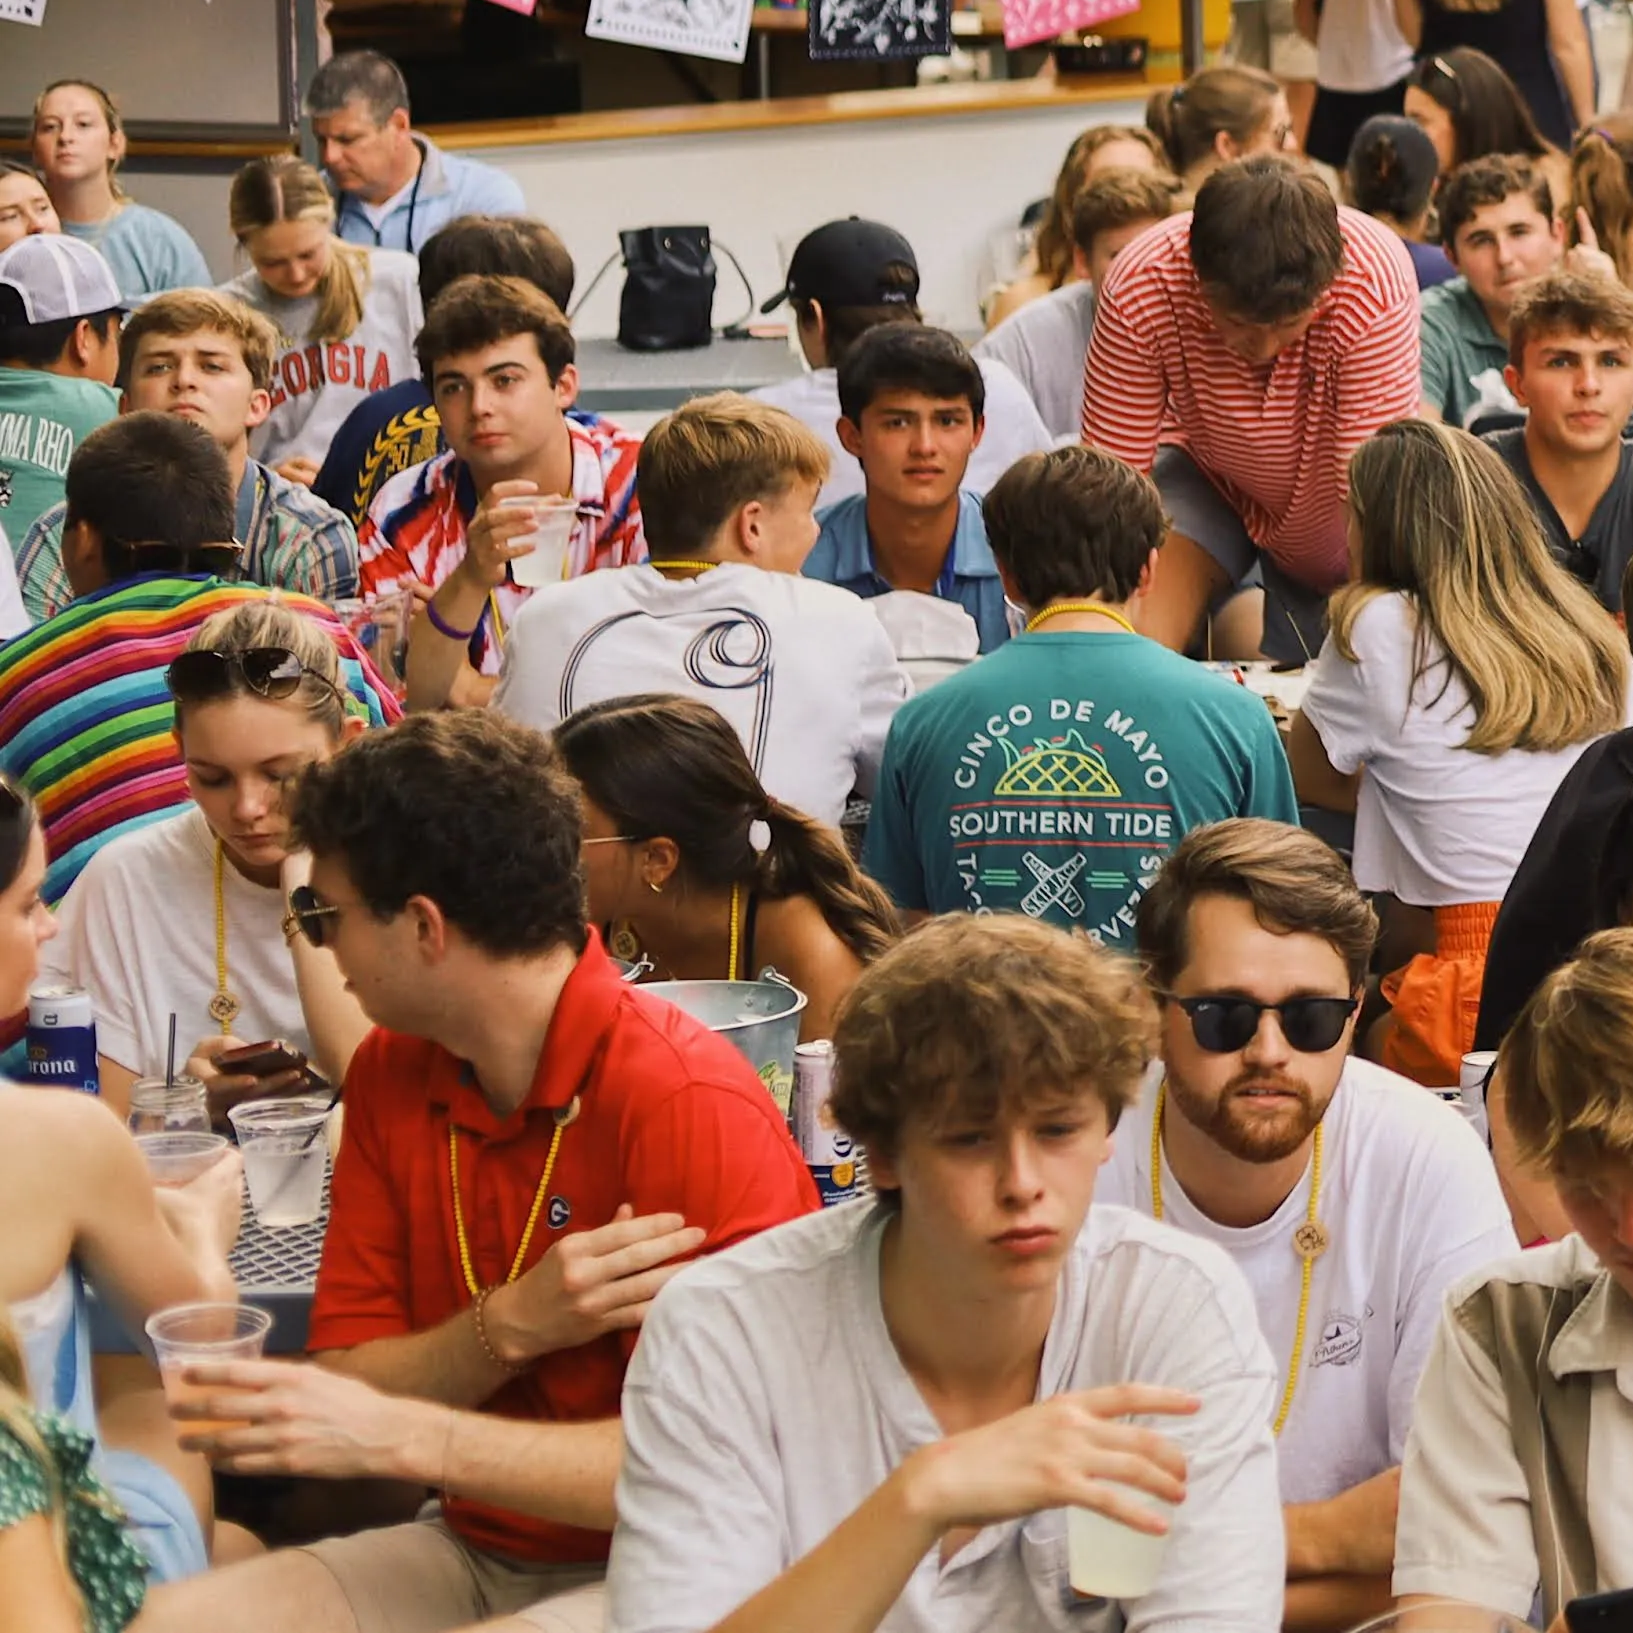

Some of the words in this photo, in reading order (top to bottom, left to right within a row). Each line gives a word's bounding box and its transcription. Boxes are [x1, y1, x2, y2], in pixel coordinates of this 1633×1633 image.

[270, 342, 391, 411] EORGIA
[33, 417, 73, 477] RHO
[954, 704, 1033, 789] CINCO
[1049, 699, 1095, 723] DE
[1103, 709, 1169, 790] MAYO
[949, 811, 1094, 838] SOUTHERN
[1104, 812, 1172, 838] TIDE
